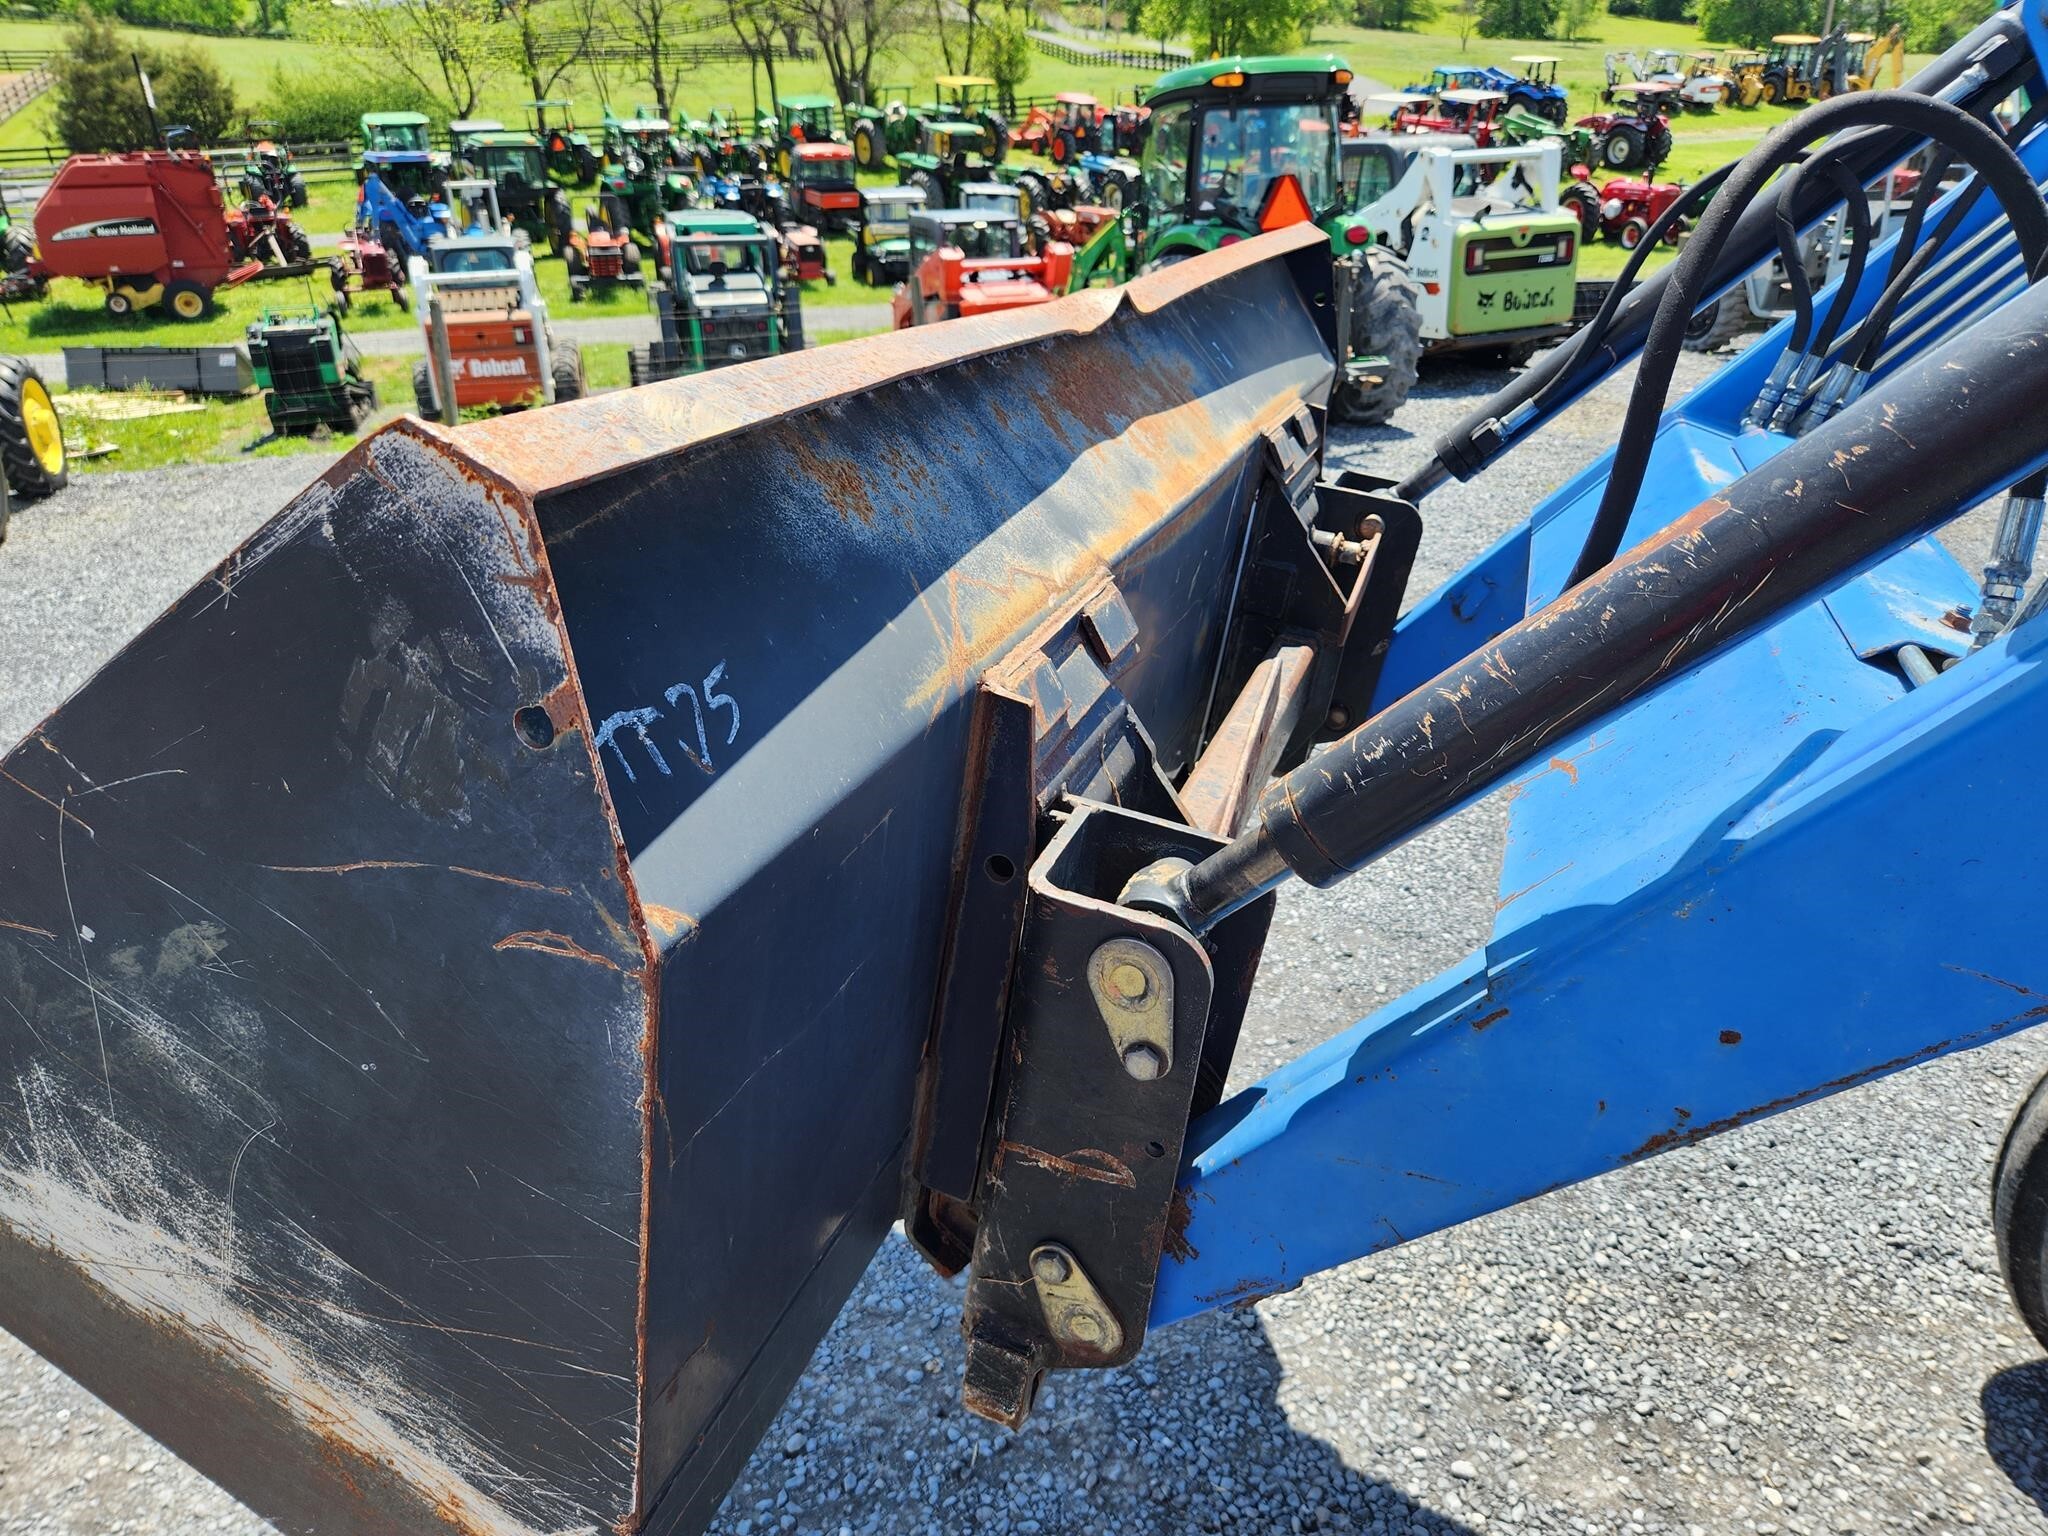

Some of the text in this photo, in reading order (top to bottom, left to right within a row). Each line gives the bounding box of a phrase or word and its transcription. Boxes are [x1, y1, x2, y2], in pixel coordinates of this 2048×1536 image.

[96, 226, 118, 237] New
[119, 224, 155, 235] Holland
[468, 357, 527, 378] Bobcat
